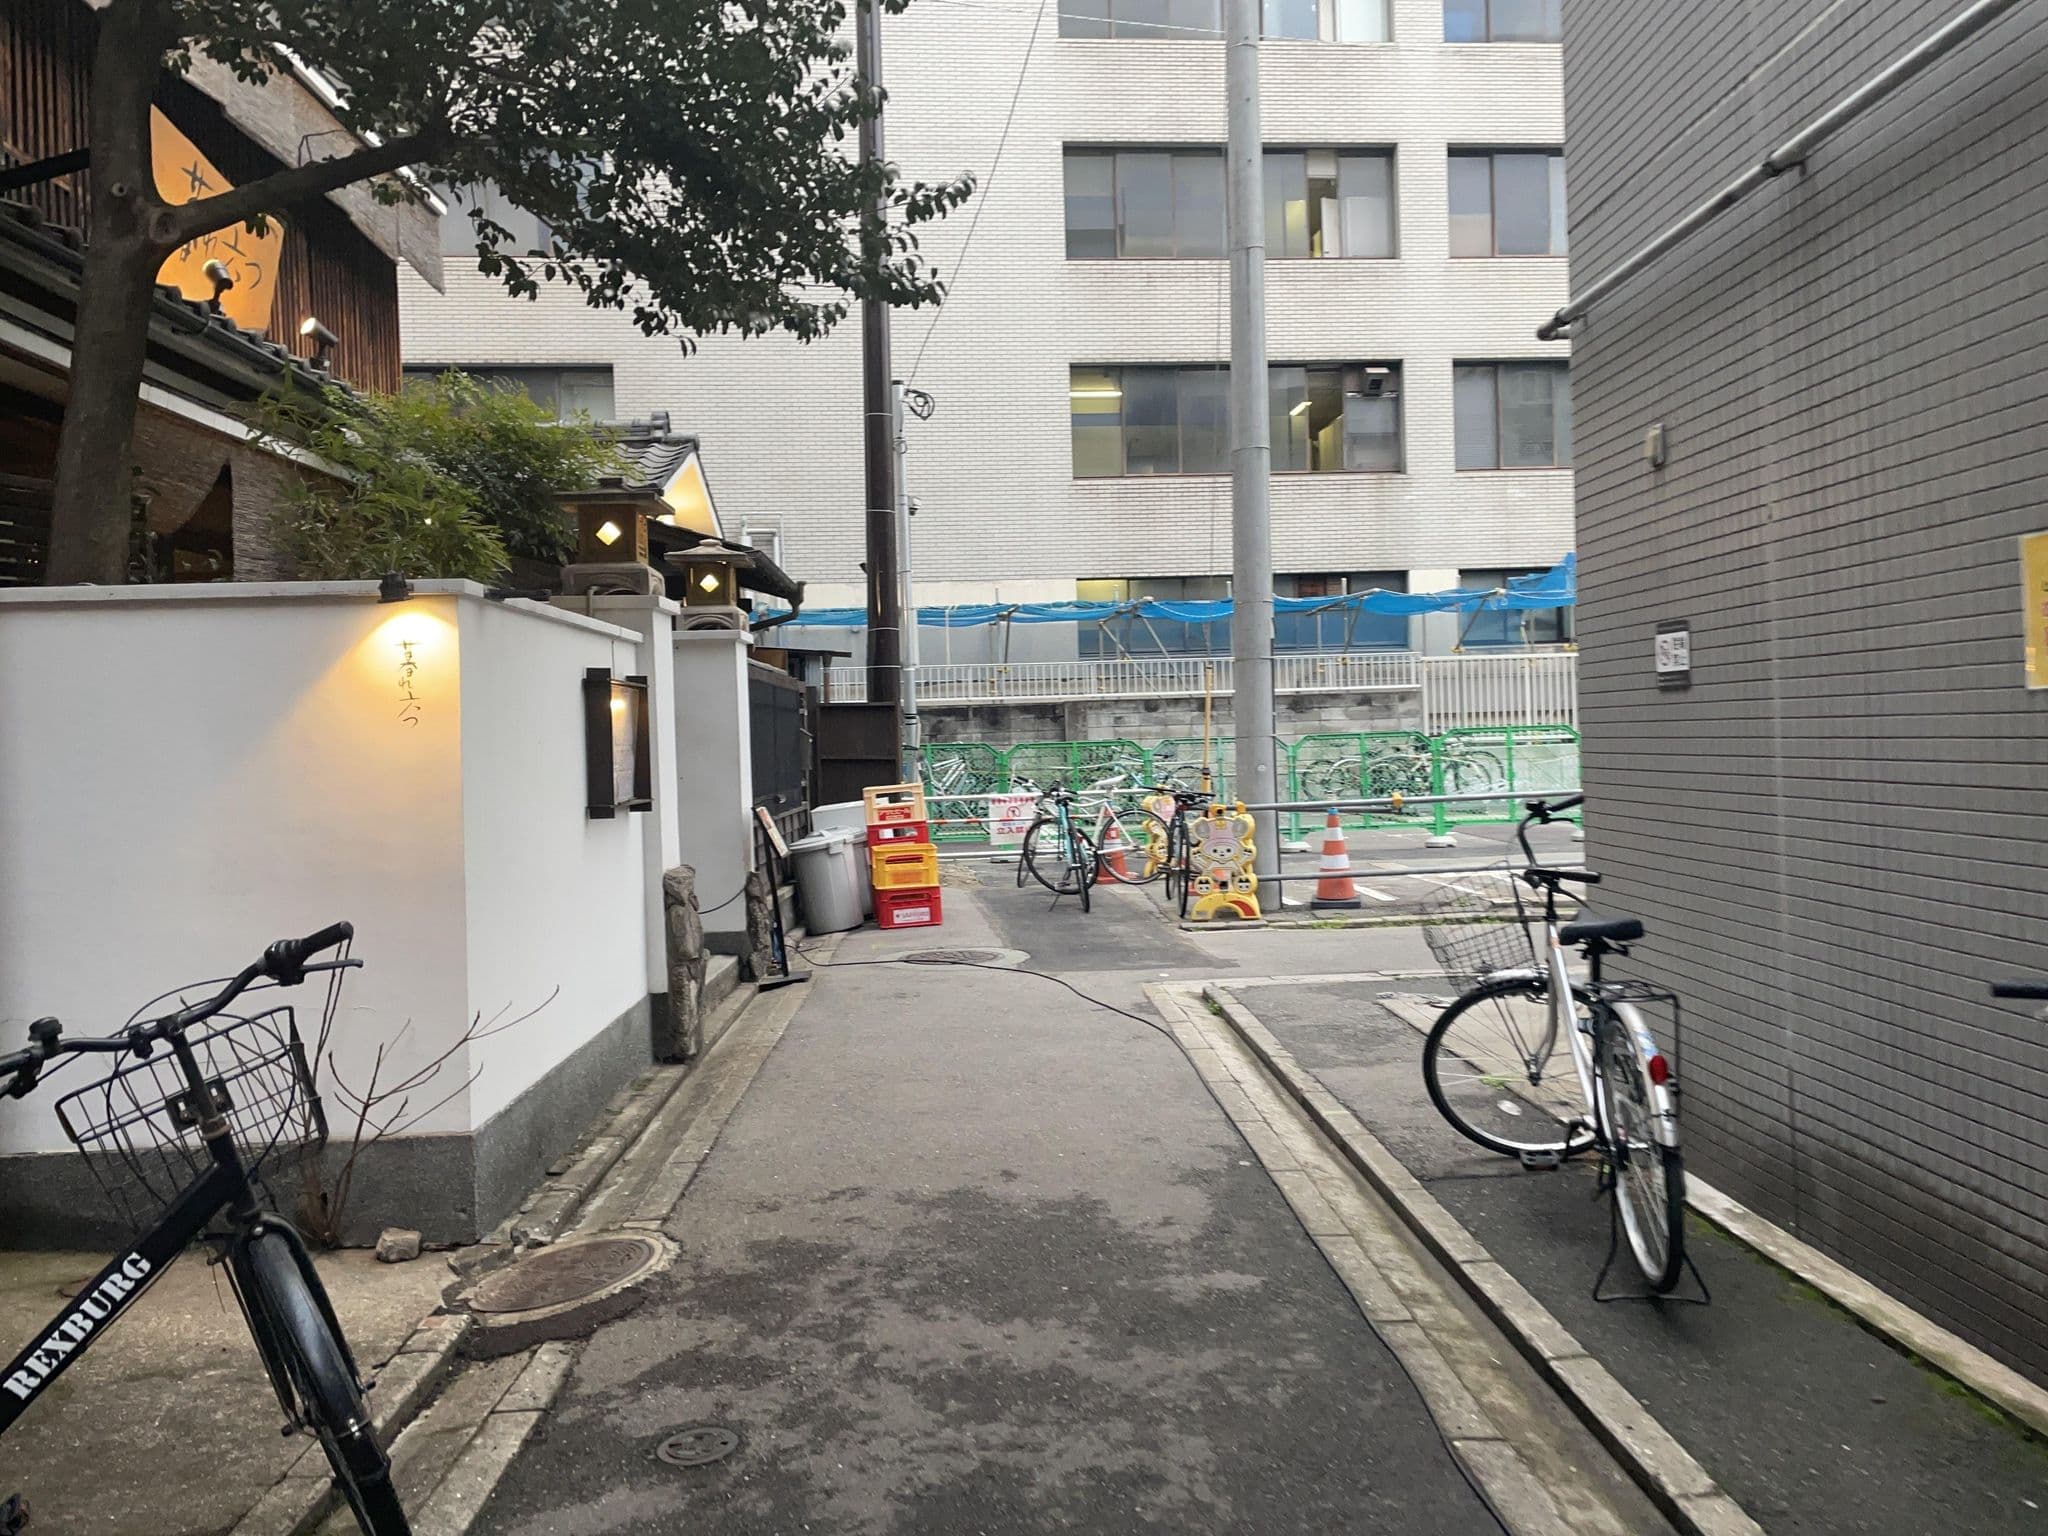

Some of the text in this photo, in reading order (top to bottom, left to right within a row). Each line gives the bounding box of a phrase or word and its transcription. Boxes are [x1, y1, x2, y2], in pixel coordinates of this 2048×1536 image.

[996, 826, 1029, 835] 立入禁
[3, 1252, 152, 1400] REXBURG
